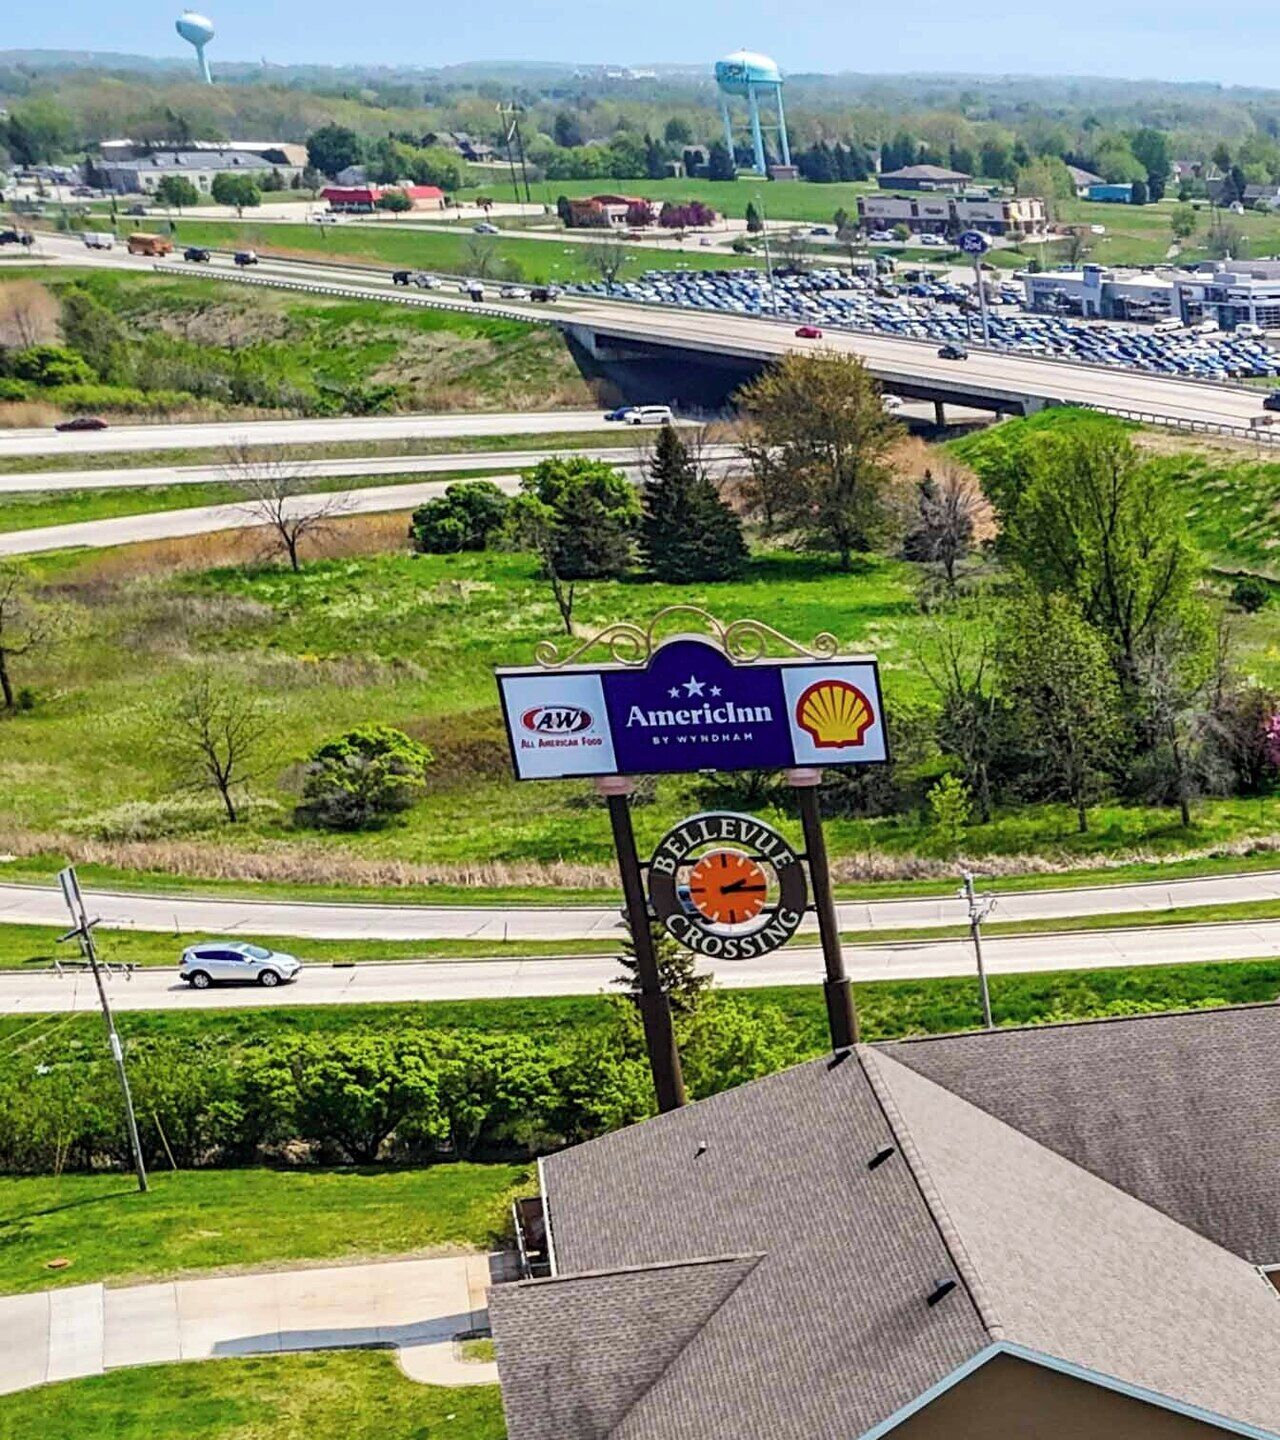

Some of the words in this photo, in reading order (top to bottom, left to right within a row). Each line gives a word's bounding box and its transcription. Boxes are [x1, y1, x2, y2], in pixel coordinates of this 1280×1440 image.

[625, 701, 773, 728] AmericInn
[652, 736, 669, 746] BY
[675, 732, 754, 745] WYNDHAM
[653, 818, 795, 876] BELLEVUE
[665, 908, 800, 960] CROSSING
